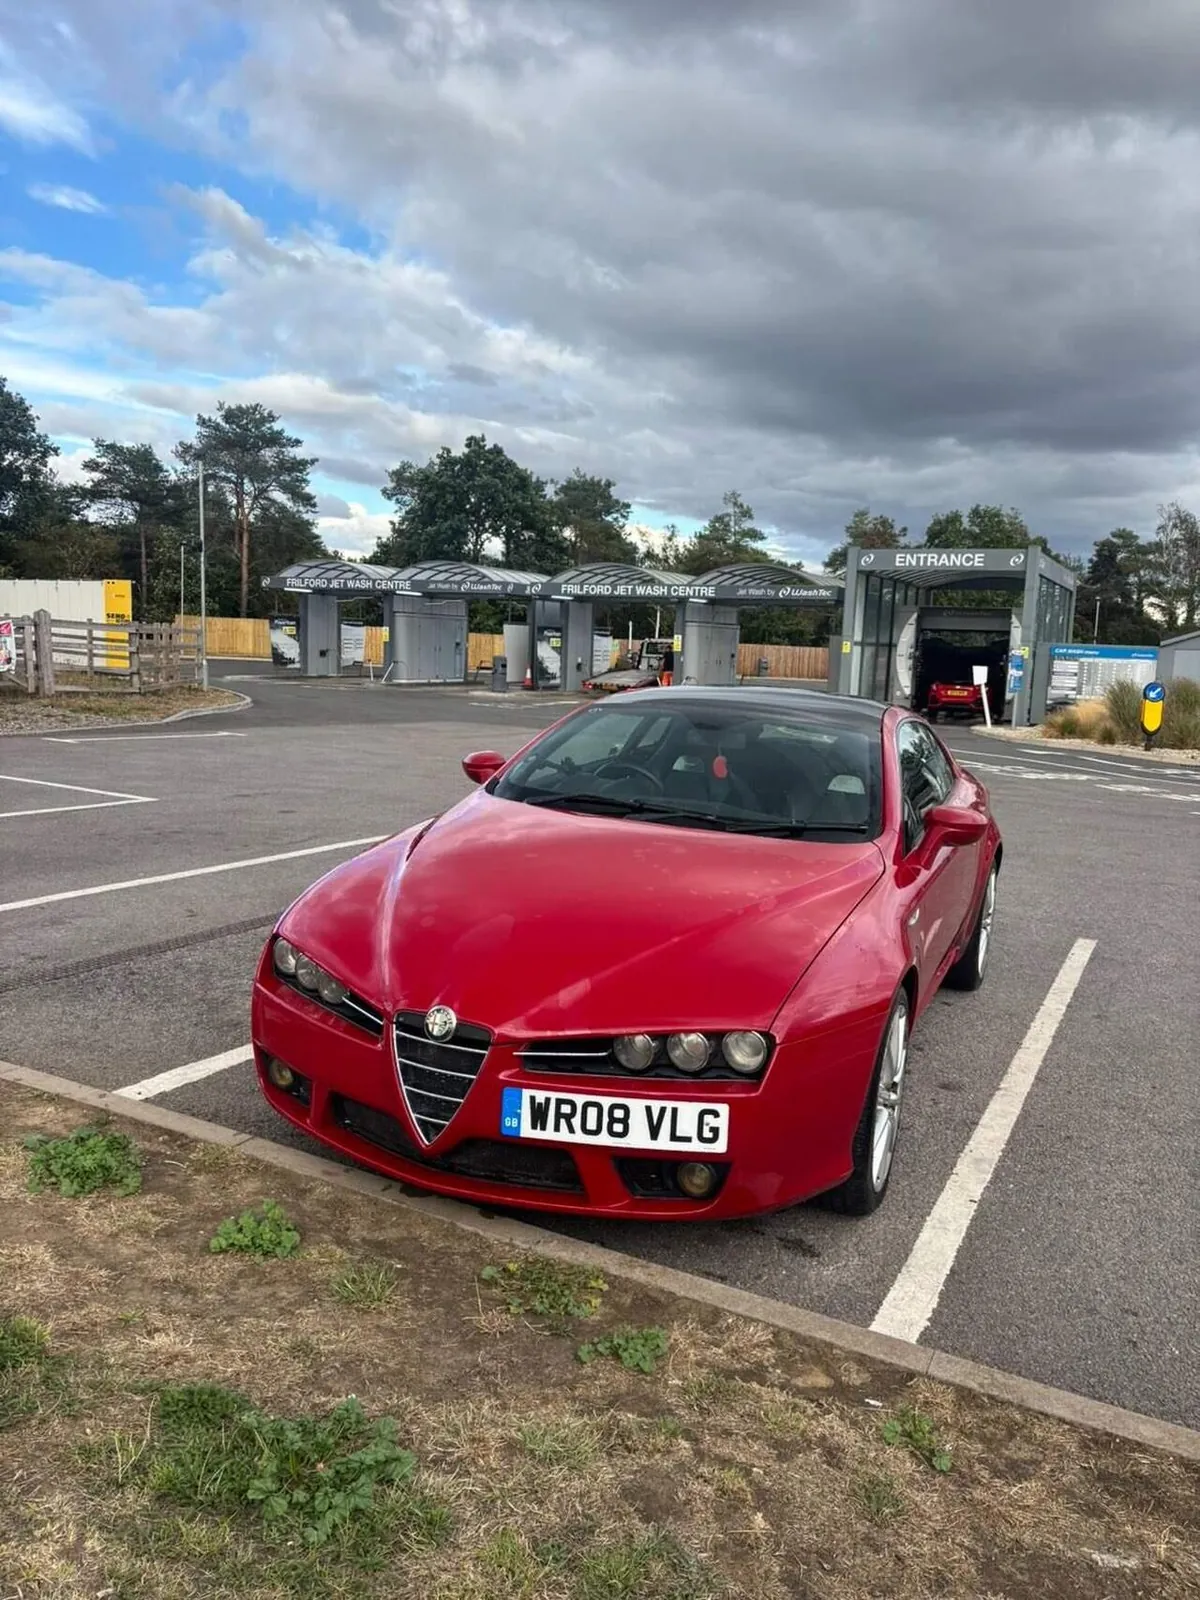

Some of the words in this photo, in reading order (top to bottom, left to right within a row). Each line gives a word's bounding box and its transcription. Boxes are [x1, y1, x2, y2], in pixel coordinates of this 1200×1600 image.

[895, 553, 985, 566] ENTRANCE
[286, 578, 328, 588] FRILFORD
[330, 579, 345, 588] JET
[346, 580, 372, 589] WASH
[375, 580, 412, 590] CENTRE
[561, 584, 612, 595] FRILFORD
[614, 585, 634, 595] JET
[635, 586, 668, 596] WASH
[670, 586, 716, 597] CENTRE
[737, 588, 746, 596] Jet
[767, 588, 776, 597] by
[792, 588, 832, 596] WashTec
[504, 1116, 518, 1128] GB
[528, 1095, 630, 1139] WR08
[644, 1104, 720, 1144] VLG
